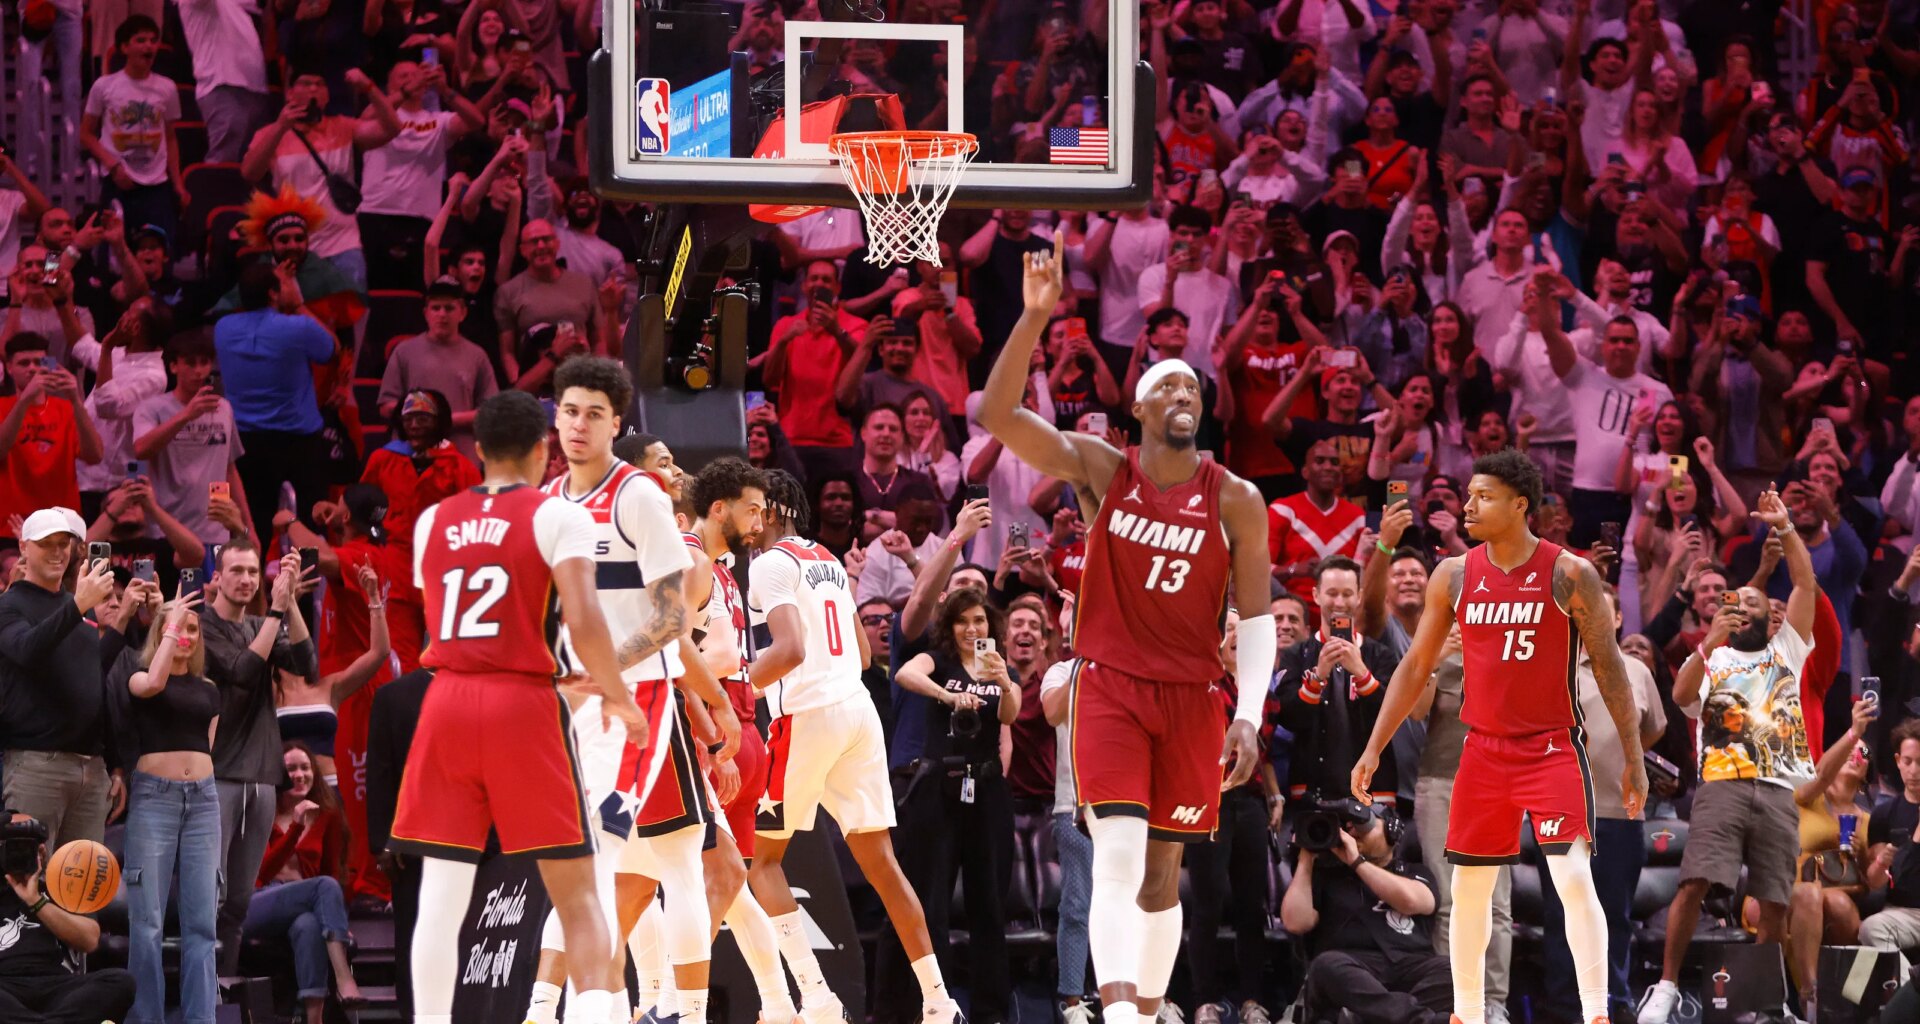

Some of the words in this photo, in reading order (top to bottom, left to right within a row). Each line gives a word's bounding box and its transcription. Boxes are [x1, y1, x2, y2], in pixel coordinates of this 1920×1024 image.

[699, 88, 729, 125] ULTRA
[641, 137, 658, 150] NBA
[445, 517, 511, 551] SMITH
[1107, 508, 1206, 555] MIAMI
[805, 563, 846, 591] COULIBALY
[1144, 554, 1192, 594] 13
[439, 564, 511, 642] 12
[1465, 602, 1545, 625] MIAMI
[824, 599, 844, 656] 0
[1501, 629, 1536, 661] 15
[944, 679, 963, 691] EL
[965, 683, 1001, 696] HEAT
[87, 854, 109, 902] Wilson
[476, 878, 528, 931] Florida
[462, 936, 494, 985] Blue
